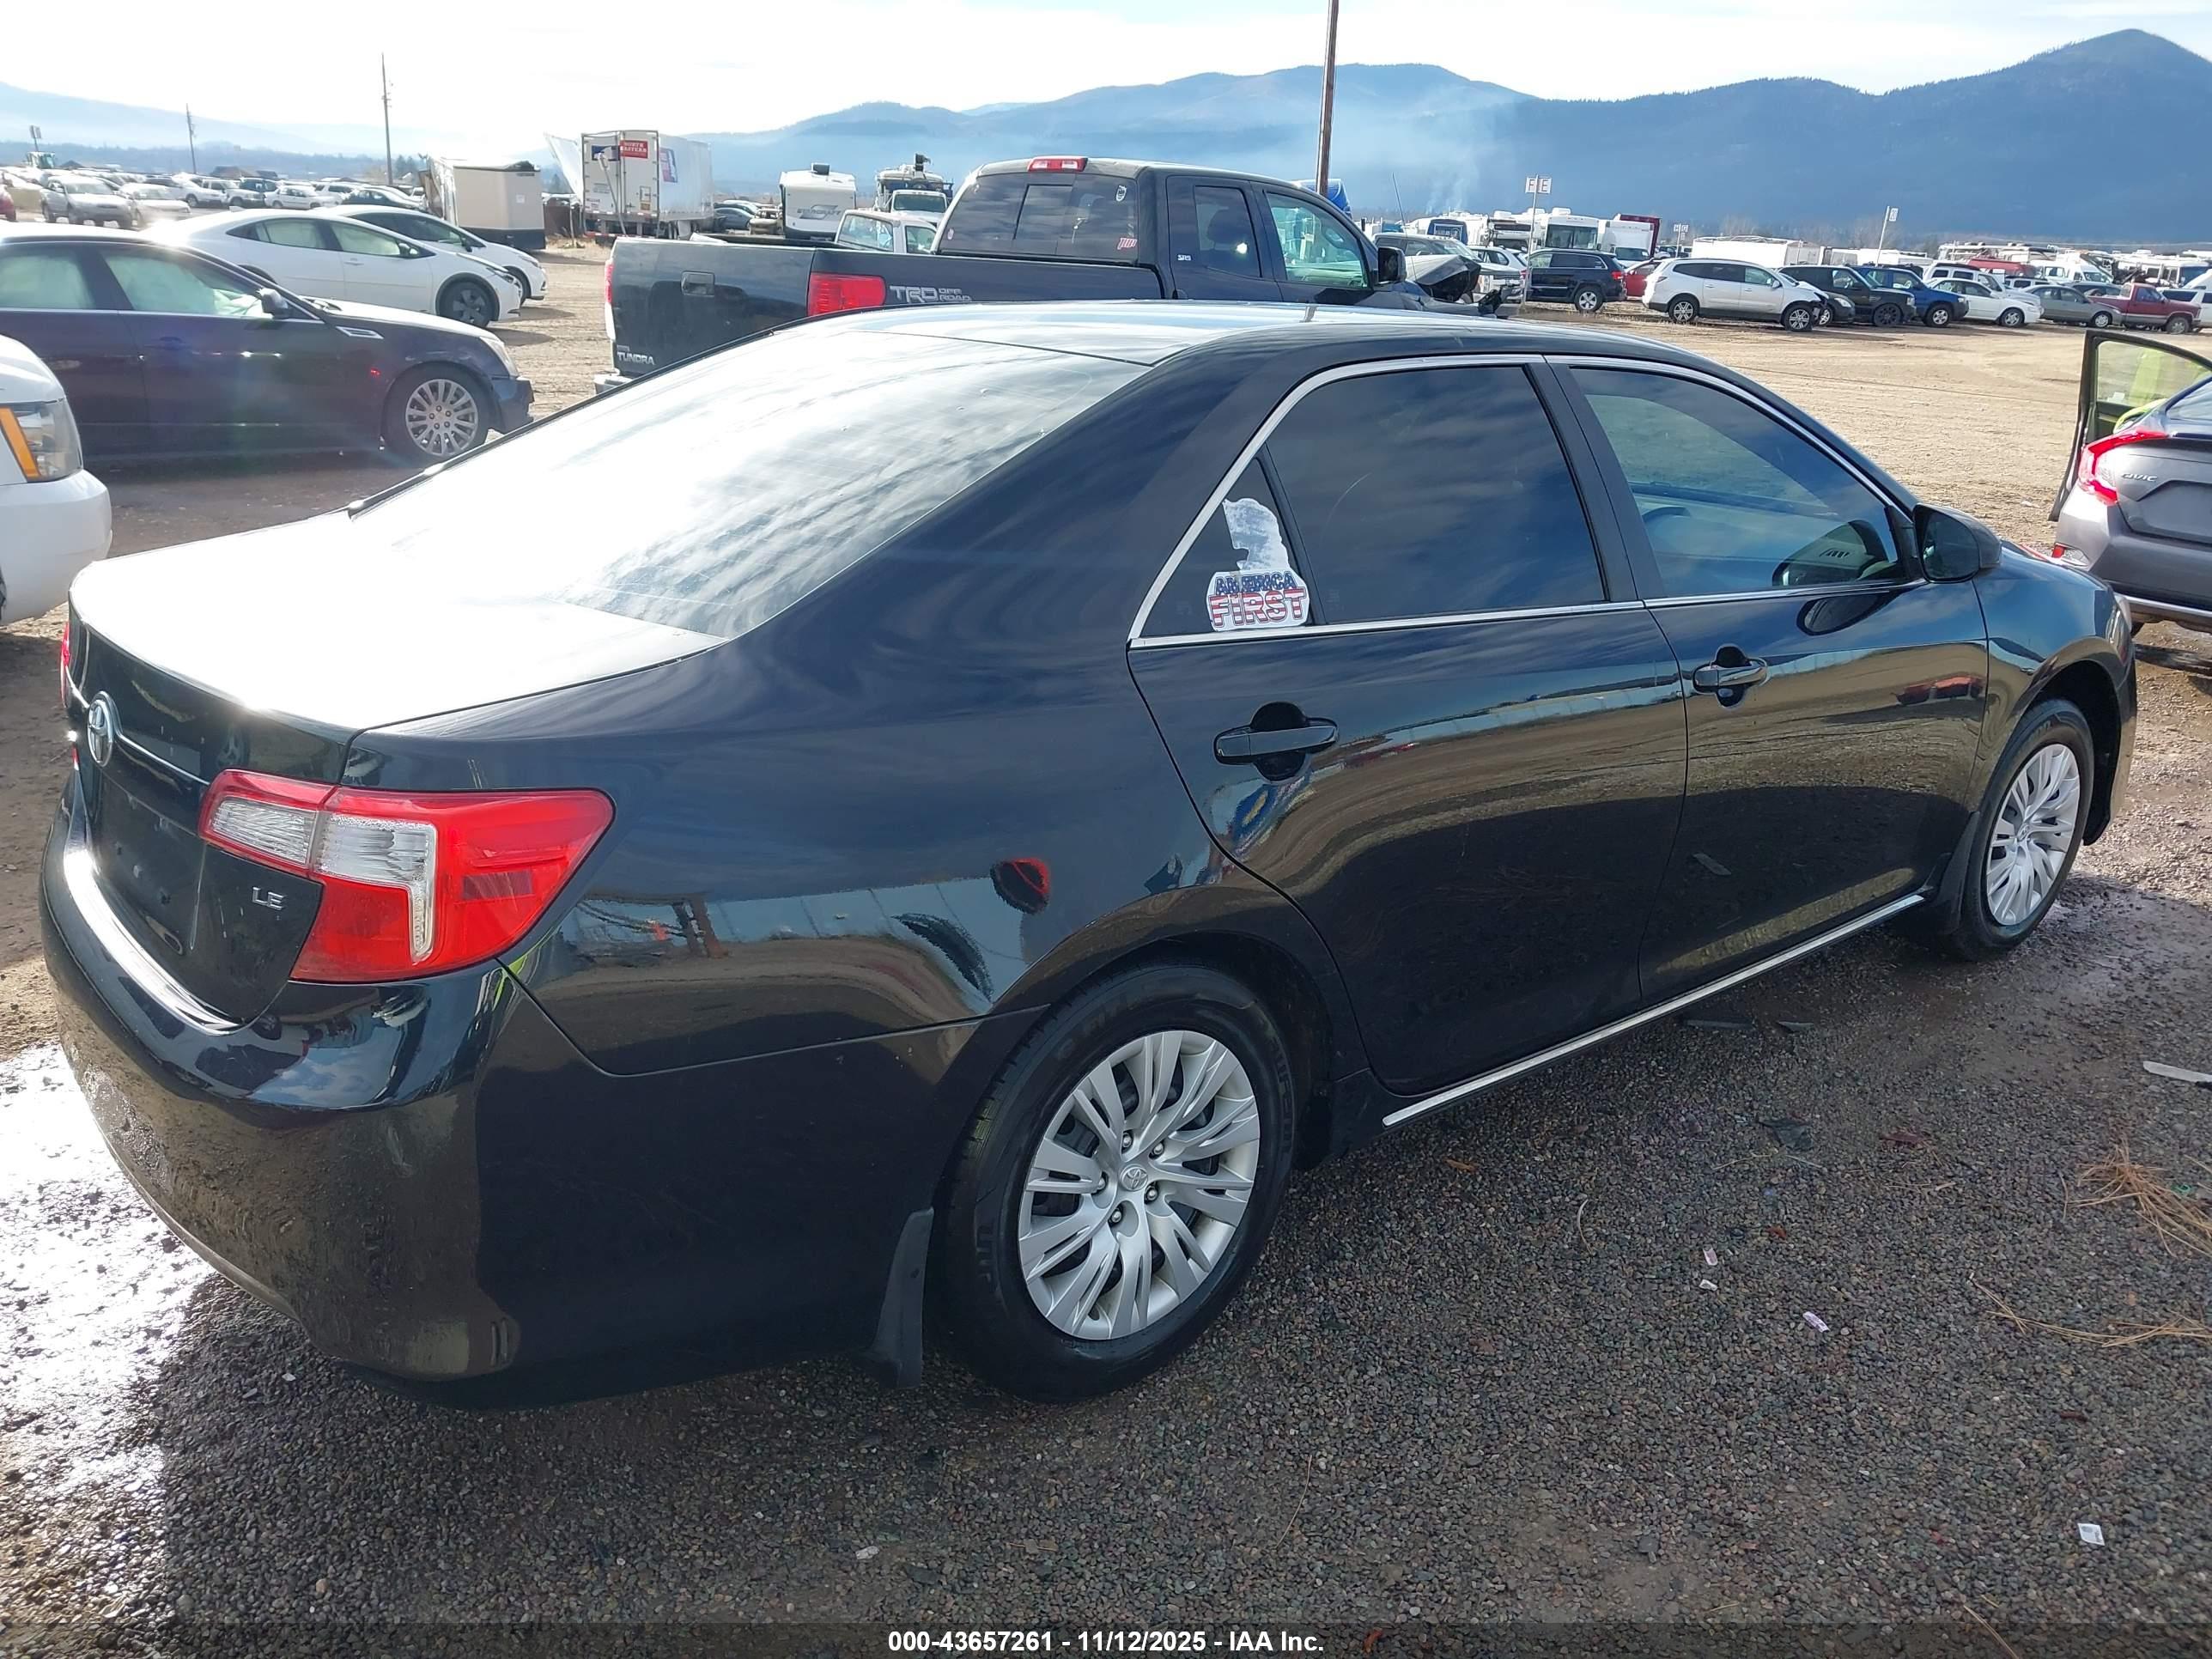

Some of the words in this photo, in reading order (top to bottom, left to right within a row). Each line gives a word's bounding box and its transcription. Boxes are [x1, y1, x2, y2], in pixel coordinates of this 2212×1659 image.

[1528, 179, 1536, 191] F
[1541, 179, 1549, 192] E
[890, 285, 939, 303] TRD
[617, 351, 656, 366] TUNDRA
[2122, 473, 2158, 482] CIVIC
[1208, 586, 1306, 629] FIRST
[252, 886, 284, 911] LE
